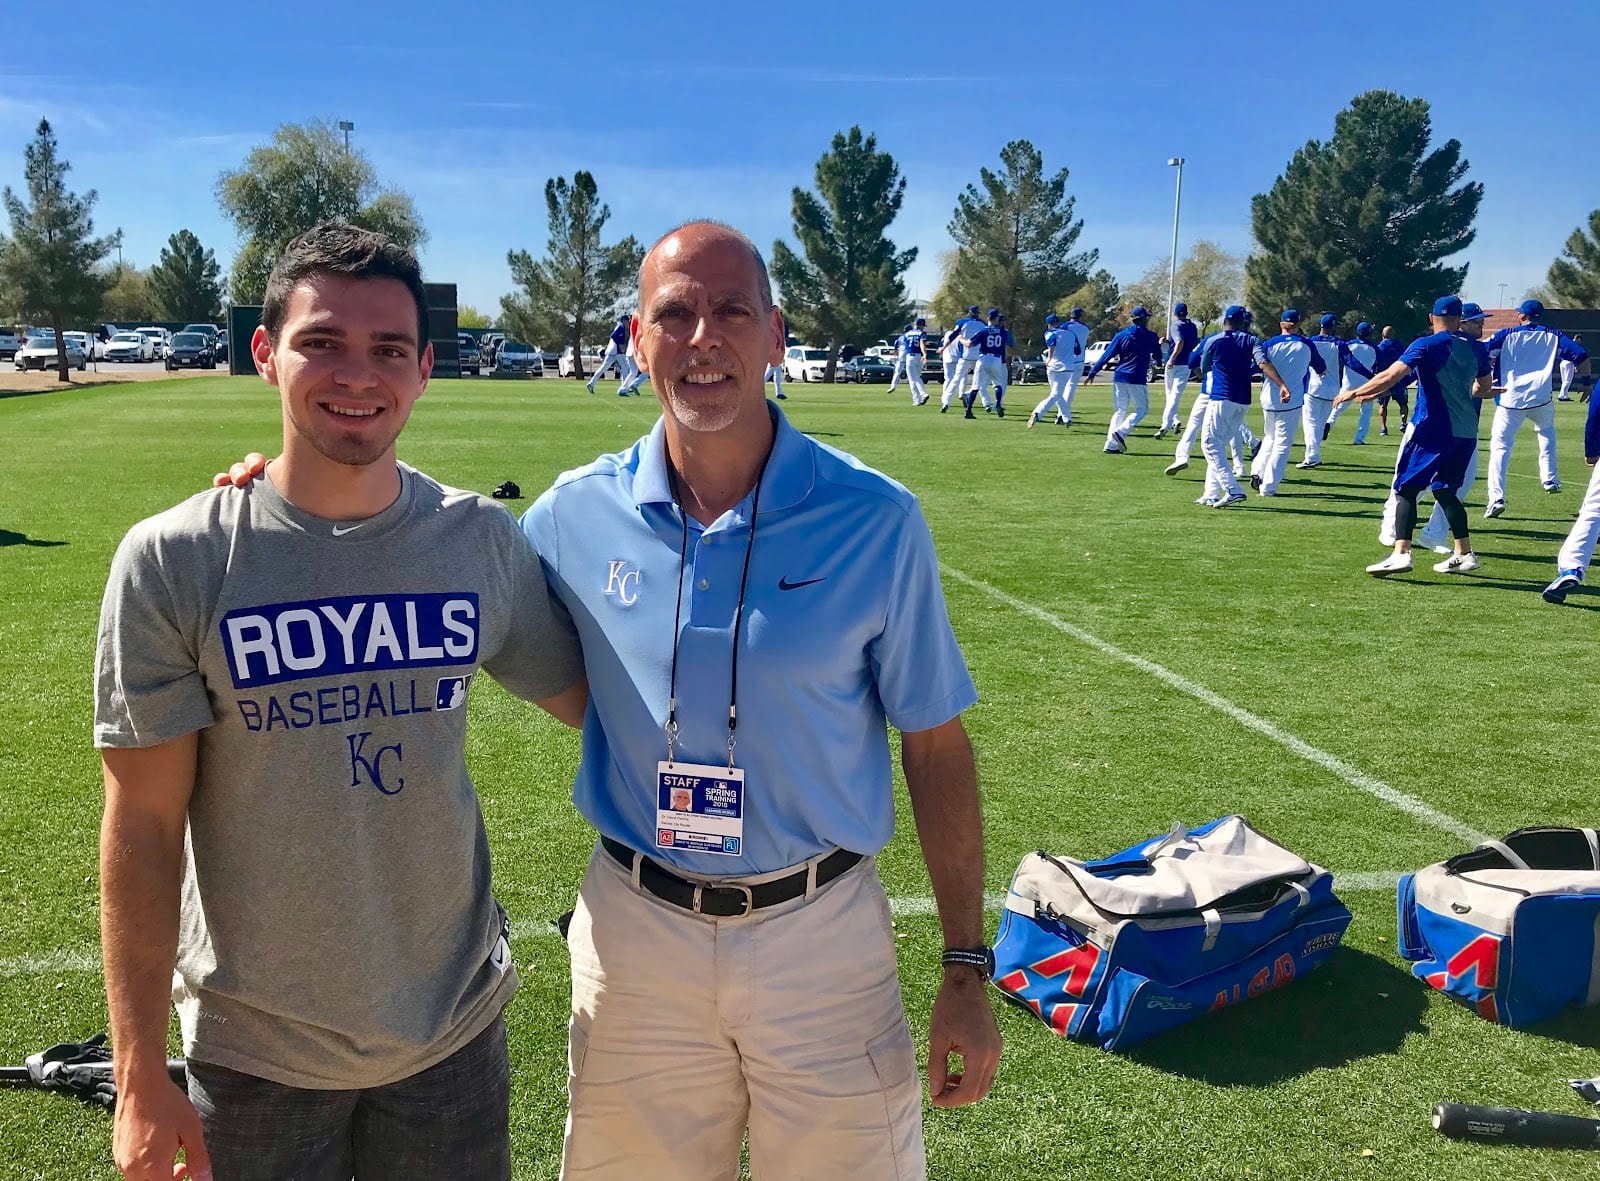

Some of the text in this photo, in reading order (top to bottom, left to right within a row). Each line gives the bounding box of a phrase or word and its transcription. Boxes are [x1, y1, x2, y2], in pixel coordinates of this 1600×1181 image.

[986, 334, 1002, 348] 60
[604, 560, 640, 607] KC
[227, 600, 475, 680] ROYALS
[237, 679, 432, 732] BASEBALL
[346, 731, 404, 795] KC
[664, 776, 700, 788] STAFF
[705, 788, 736, 797] SPRING
[705, 795, 736, 804] TRAINING
